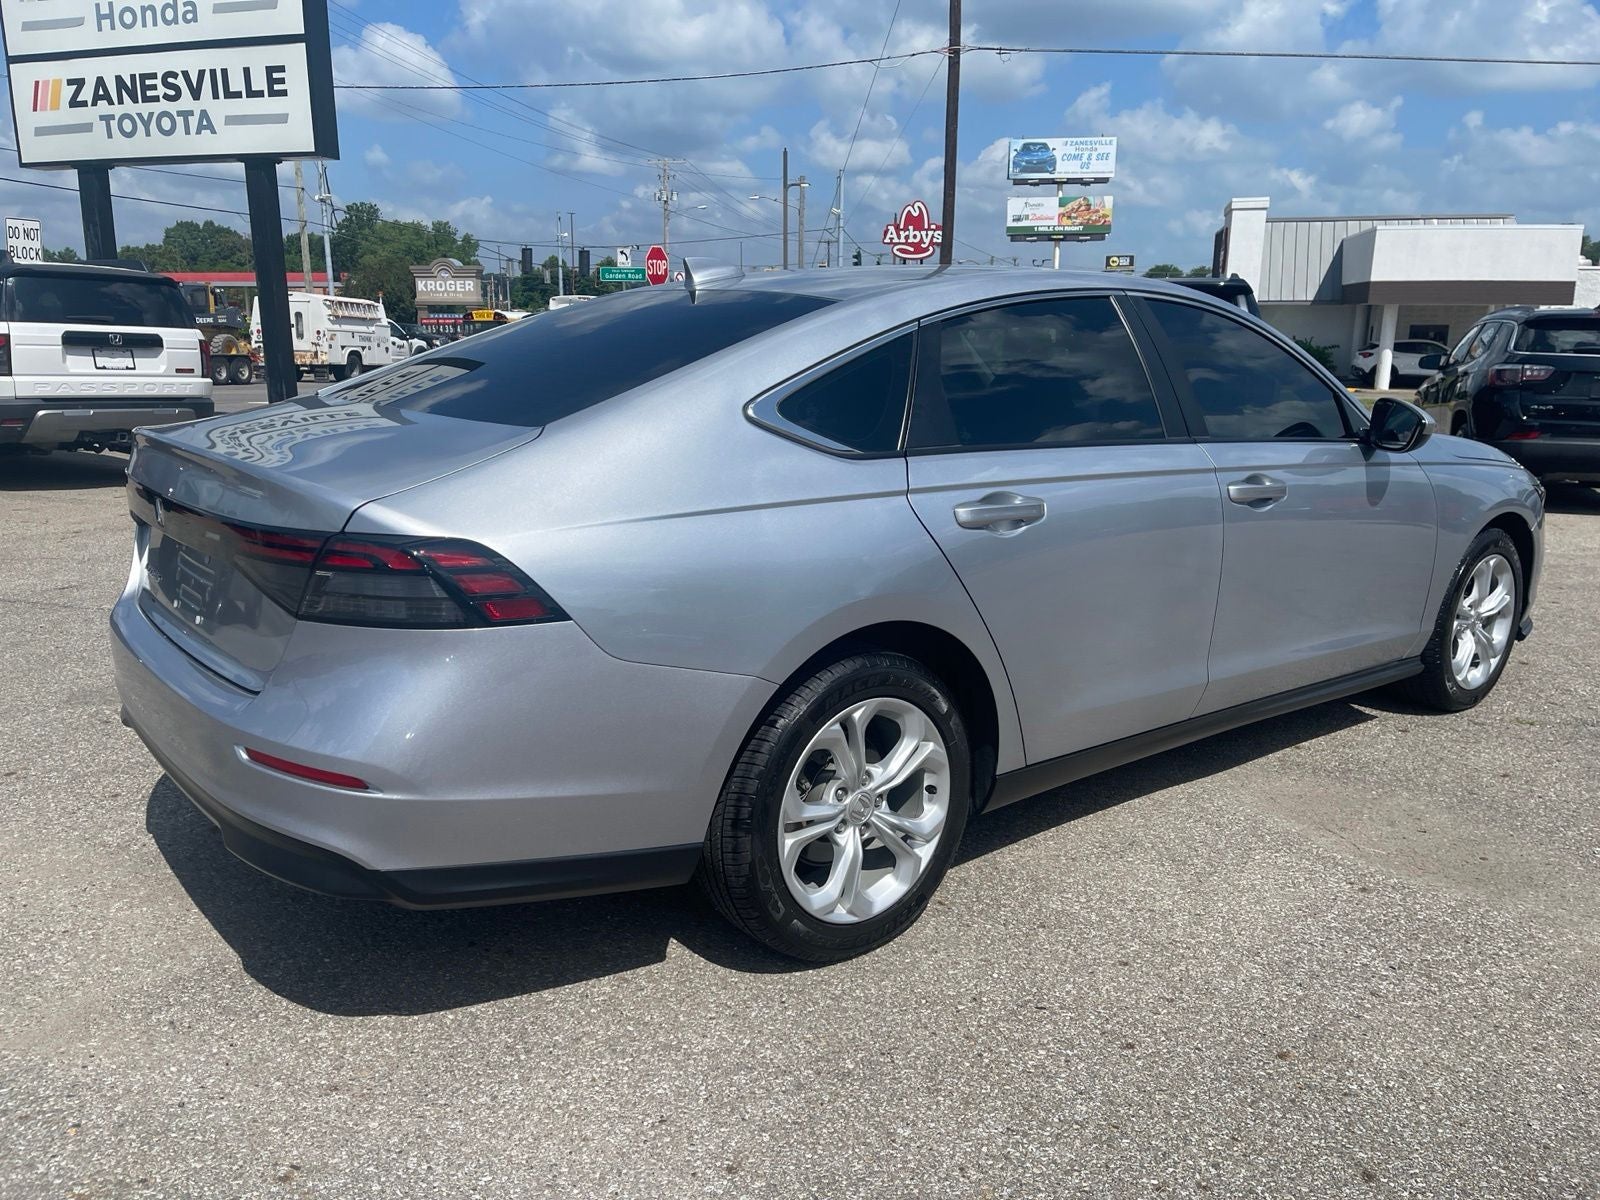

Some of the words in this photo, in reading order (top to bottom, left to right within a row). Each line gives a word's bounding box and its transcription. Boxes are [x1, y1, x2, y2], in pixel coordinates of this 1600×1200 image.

[94, 0, 199, 32] Honda
[66, 64, 289, 109] ZANESVILLE
[98, 108, 218, 139] TOYOTA
[1070, 139, 1114, 147] ZANESVILLE
[1061, 153, 1085, 162] COME
[1086, 153, 1093, 161] &
[1095, 152, 1111, 161] SEE
[1080, 161, 1091, 170] US
[8, 225, 20, 240] DO
[23, 226, 40, 241] NOT
[883, 224, 943, 248] Arby's
[9, 245, 41, 261] BLOCK
[647, 259, 667, 276] STOP
[417, 280, 474, 291] KROGER
[33, 382, 194, 393] PASSPORT
